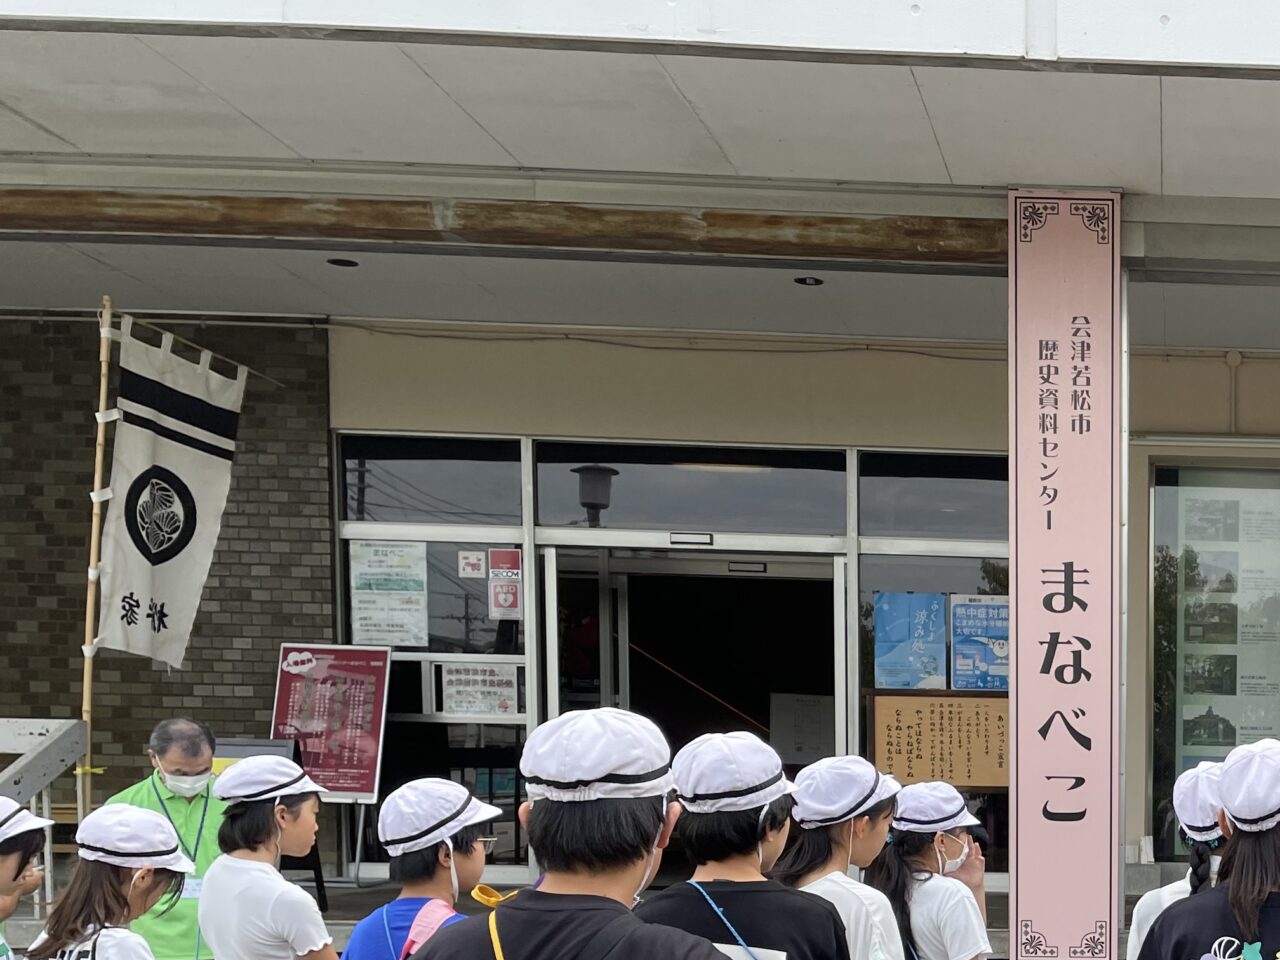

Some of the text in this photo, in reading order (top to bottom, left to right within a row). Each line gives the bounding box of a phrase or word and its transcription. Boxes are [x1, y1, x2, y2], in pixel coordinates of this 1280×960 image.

[1038, 339, 1059, 531] 歴史資料センター
[1071, 316, 1091, 435] 会津若松市
[1037, 561, 1092, 822] まなべこ
